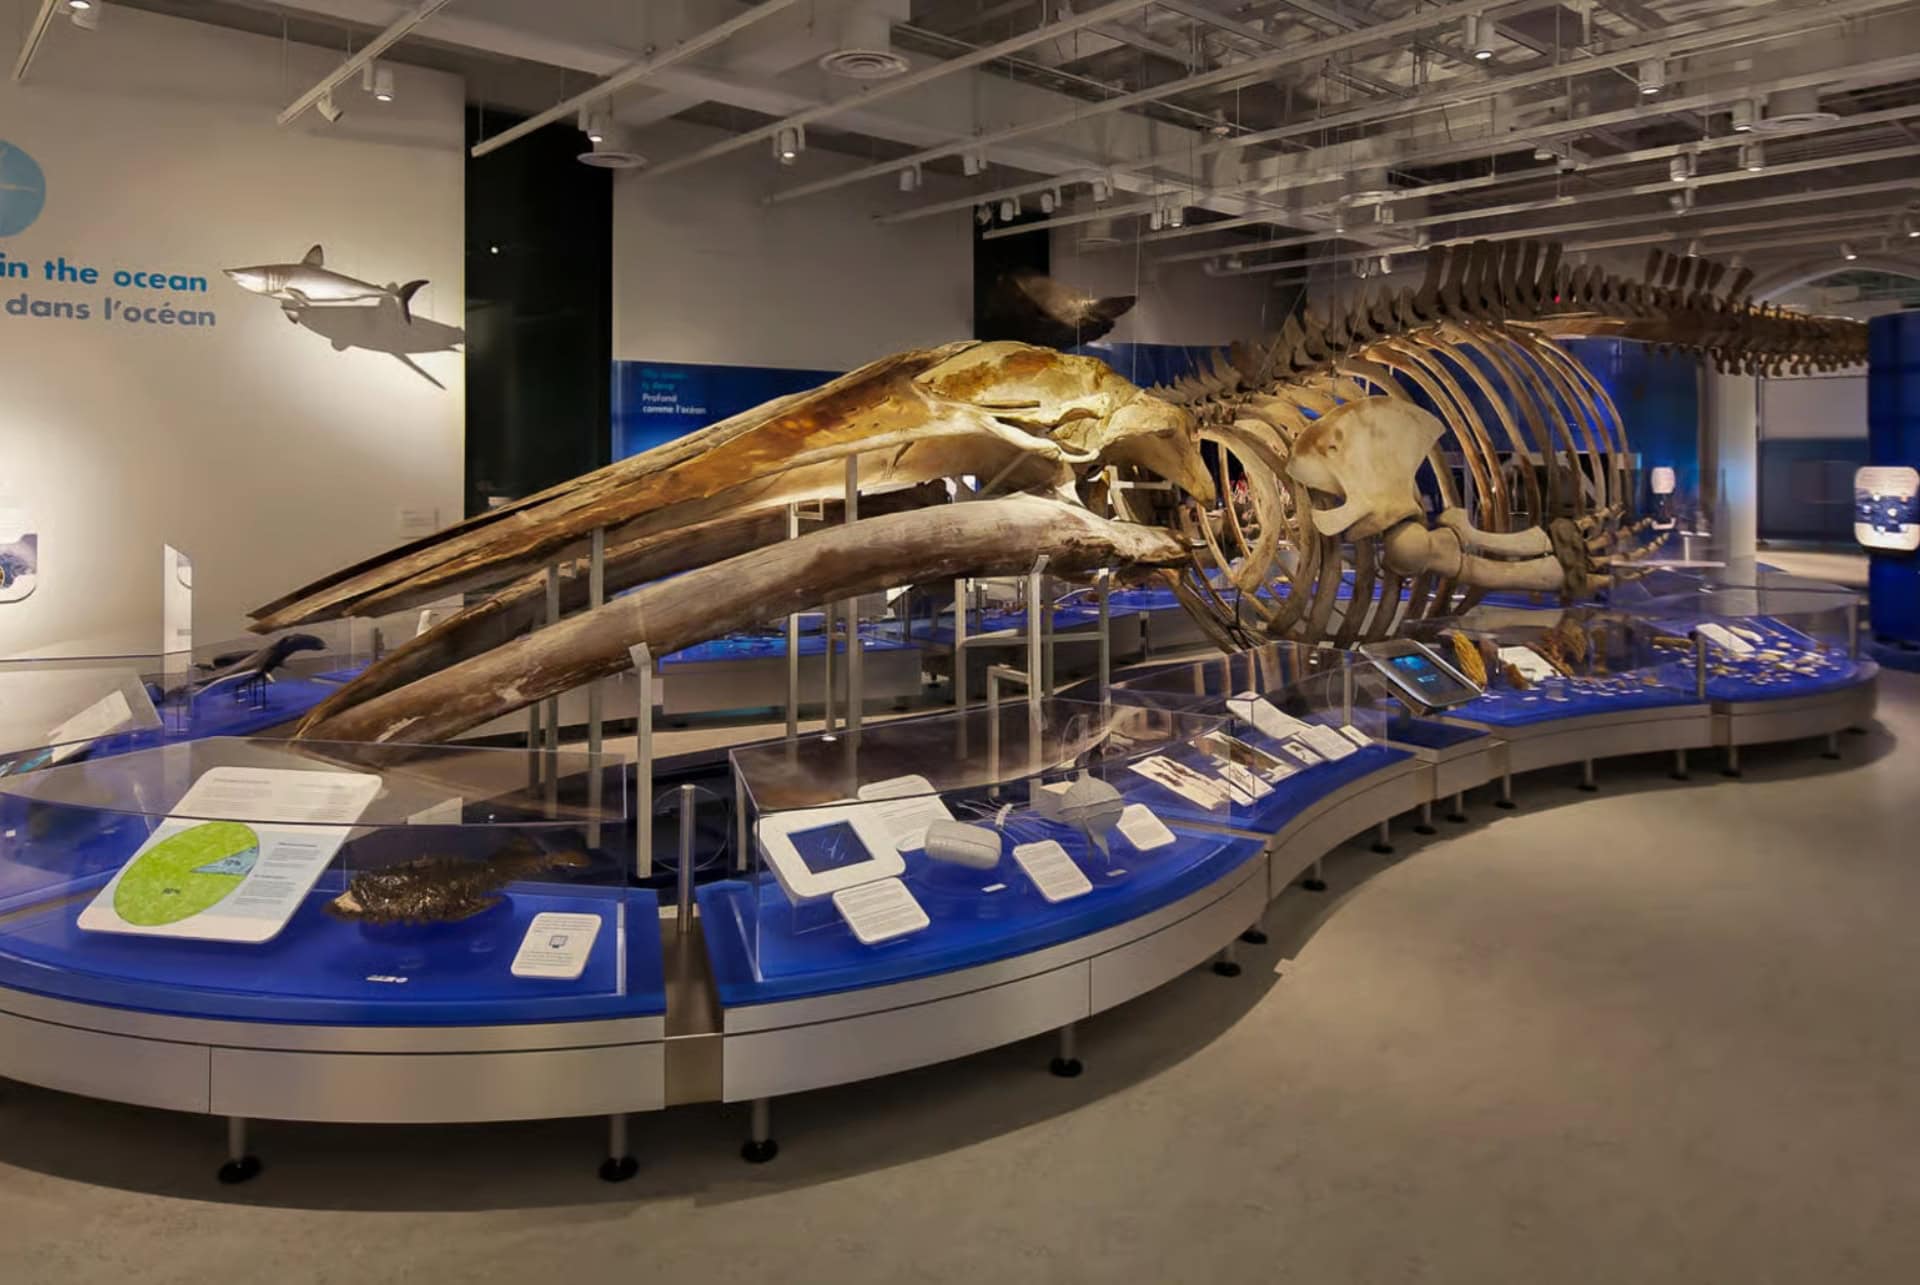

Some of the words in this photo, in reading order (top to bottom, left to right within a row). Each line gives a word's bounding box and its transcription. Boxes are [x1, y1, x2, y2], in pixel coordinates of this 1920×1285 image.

[0, 253, 29, 278] in
[44, 257, 99, 284] the
[113, 270, 208, 292] ocean
[5, 293, 91, 320] dans
[104, 297, 216, 326] l'océan
